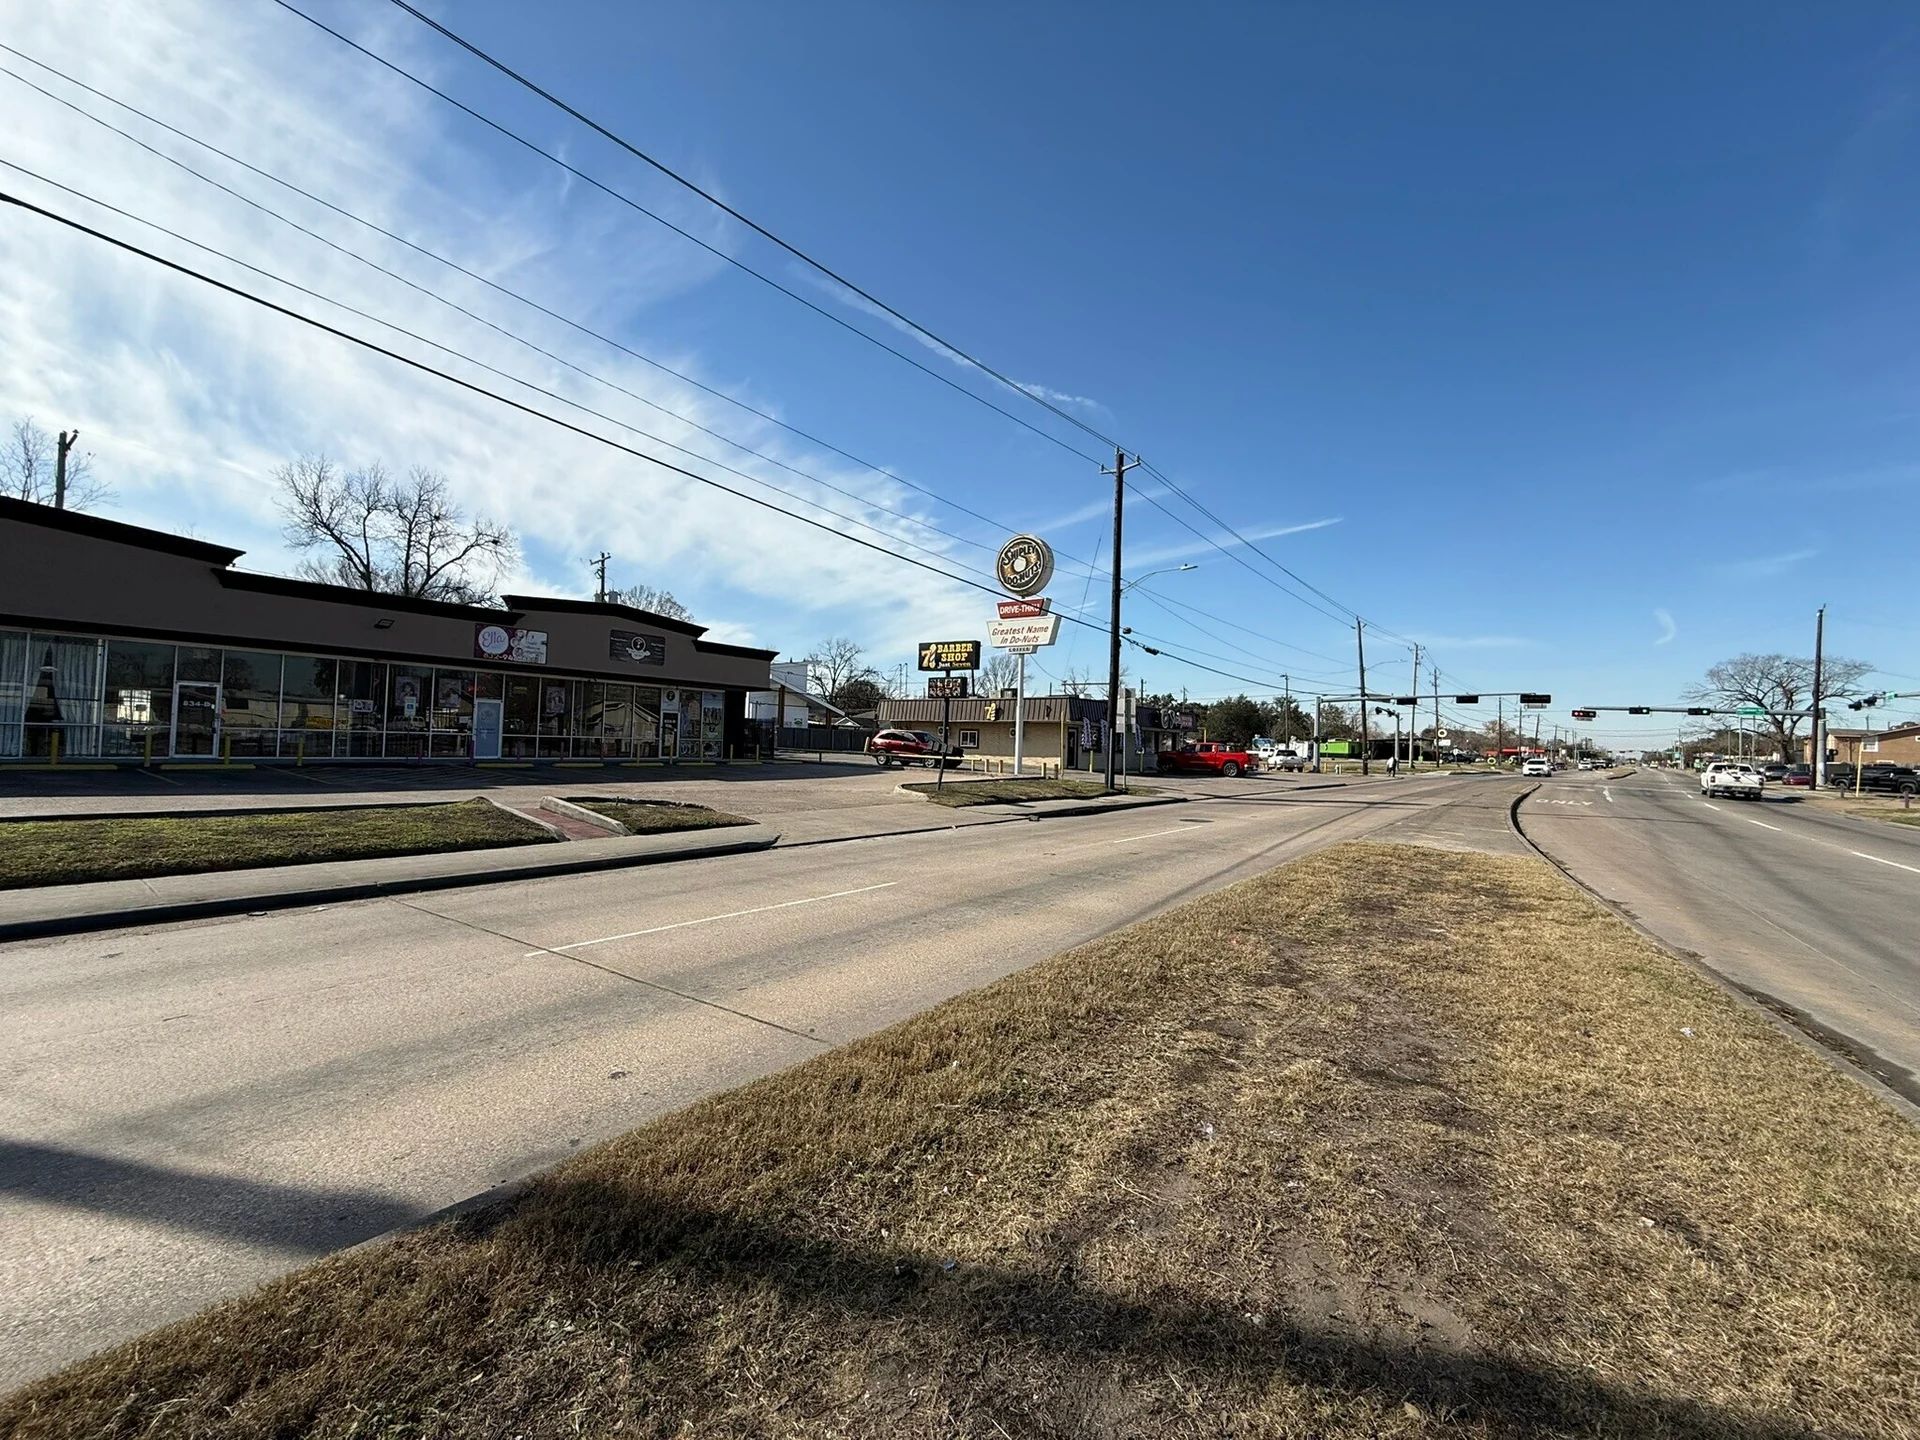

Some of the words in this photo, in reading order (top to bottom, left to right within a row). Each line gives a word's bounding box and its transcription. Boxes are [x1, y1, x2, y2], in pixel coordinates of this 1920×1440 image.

[1002, 545, 1036, 565] SHIPLEY
[1006, 560, 1041, 584] DO-NUTS
[999, 603, 1040, 614] DRIVE-THRU
[992, 627, 1024, 636] Greatest
[1026, 625, 1049, 634] Name
[1009, 635, 1040, 644] Do-Nuts
[937, 643, 973, 653] BARBER
[941, 653, 968, 661] SHOP
